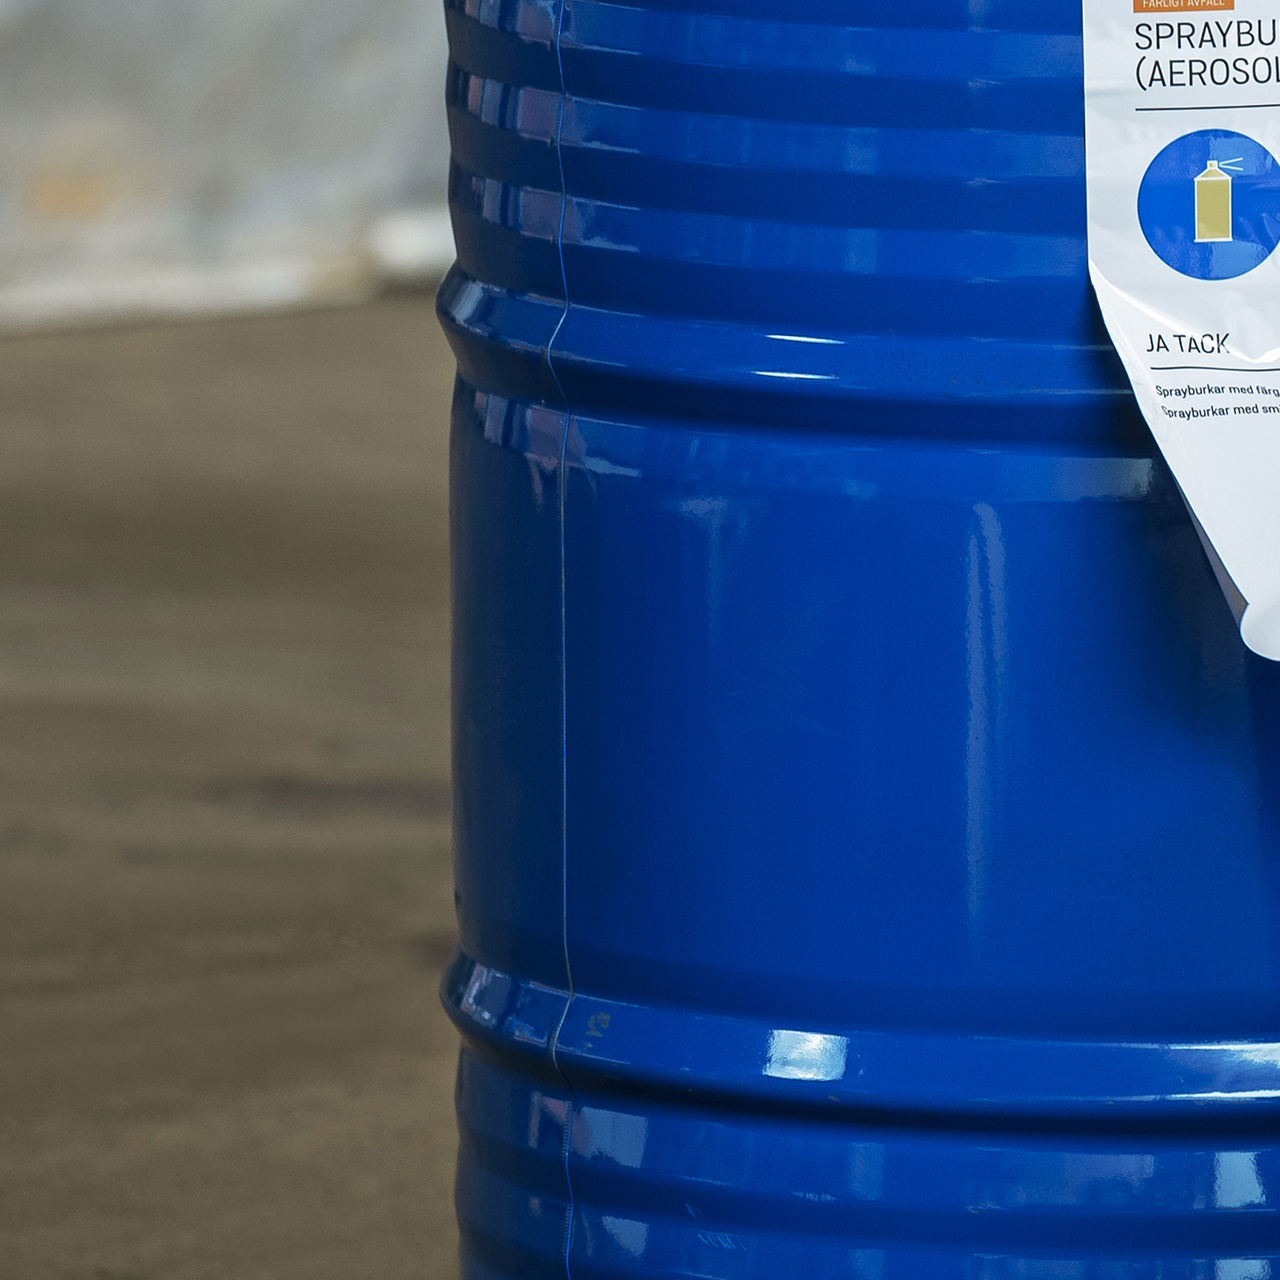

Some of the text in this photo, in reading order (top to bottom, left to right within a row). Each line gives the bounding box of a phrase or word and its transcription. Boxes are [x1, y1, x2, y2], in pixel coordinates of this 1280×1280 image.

[1146, 333, 1230, 354] JA TACK
[1155, 384, 1280, 399] Sprayburkar med färg
[1161, 405, 1230, 421] Sprayburkar
[1233, 404, 1259, 415] med
